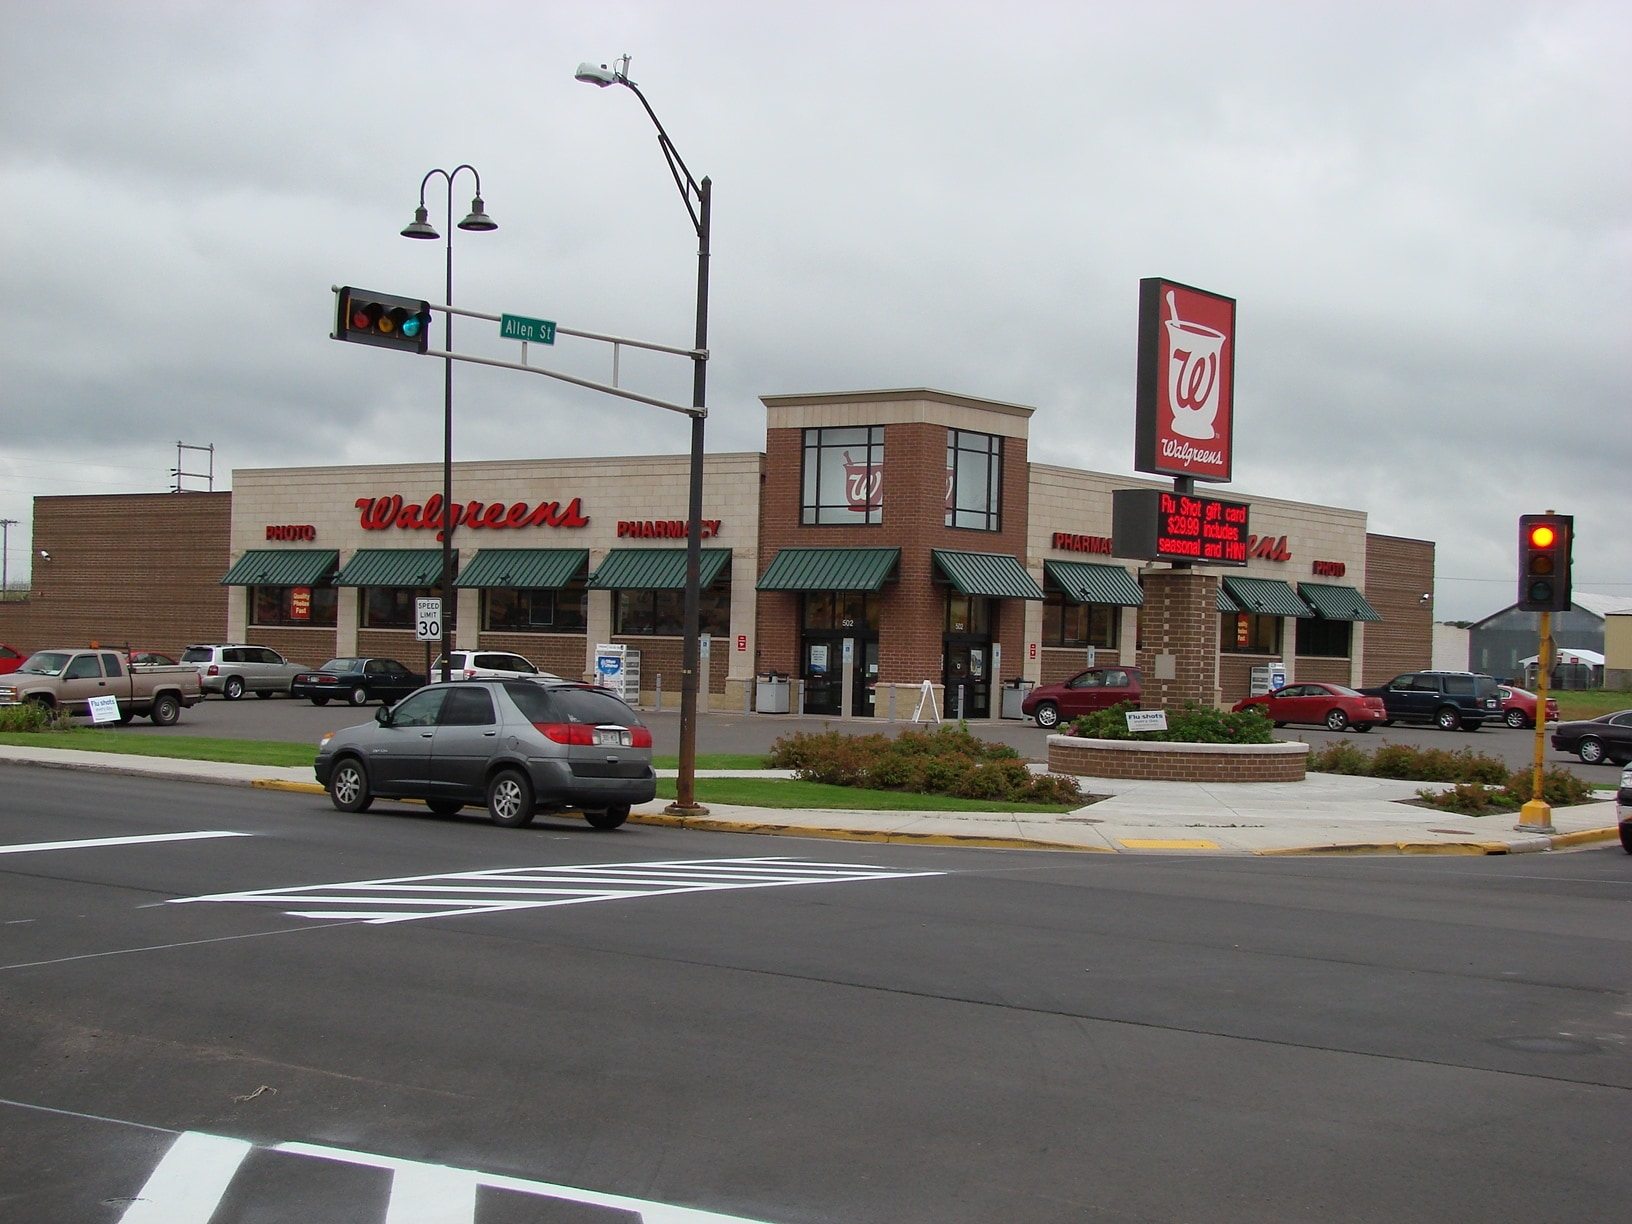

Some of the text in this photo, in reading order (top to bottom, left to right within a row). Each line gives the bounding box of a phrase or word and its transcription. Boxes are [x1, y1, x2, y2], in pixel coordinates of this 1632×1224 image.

[505, 319, 551, 340] Allen St
[1173, 348, 1217, 411] W
[1161, 438, 1223, 467] Walgreens
[1161, 493, 1246, 524] Flu Shot gift card
[355, 493, 590, 542] Walgreens
[266, 524, 315, 541] PHOTO
[1167, 514, 1239, 541] $29.99 includes
[1159, 537, 1201, 556] seasonal
[1204, 541, 1222, 558] and
[1313, 560, 1346, 577] PHOTO
[293, 592, 310, 601] Quality
[418, 602, 440, 610] SPEED
[420, 611, 437, 619] LIMIT
[842, 619, 854, 627] 502
[418, 620, 440, 636] 30
[955, 622, 964, 630] 502
[100, 699, 116, 707] shots
